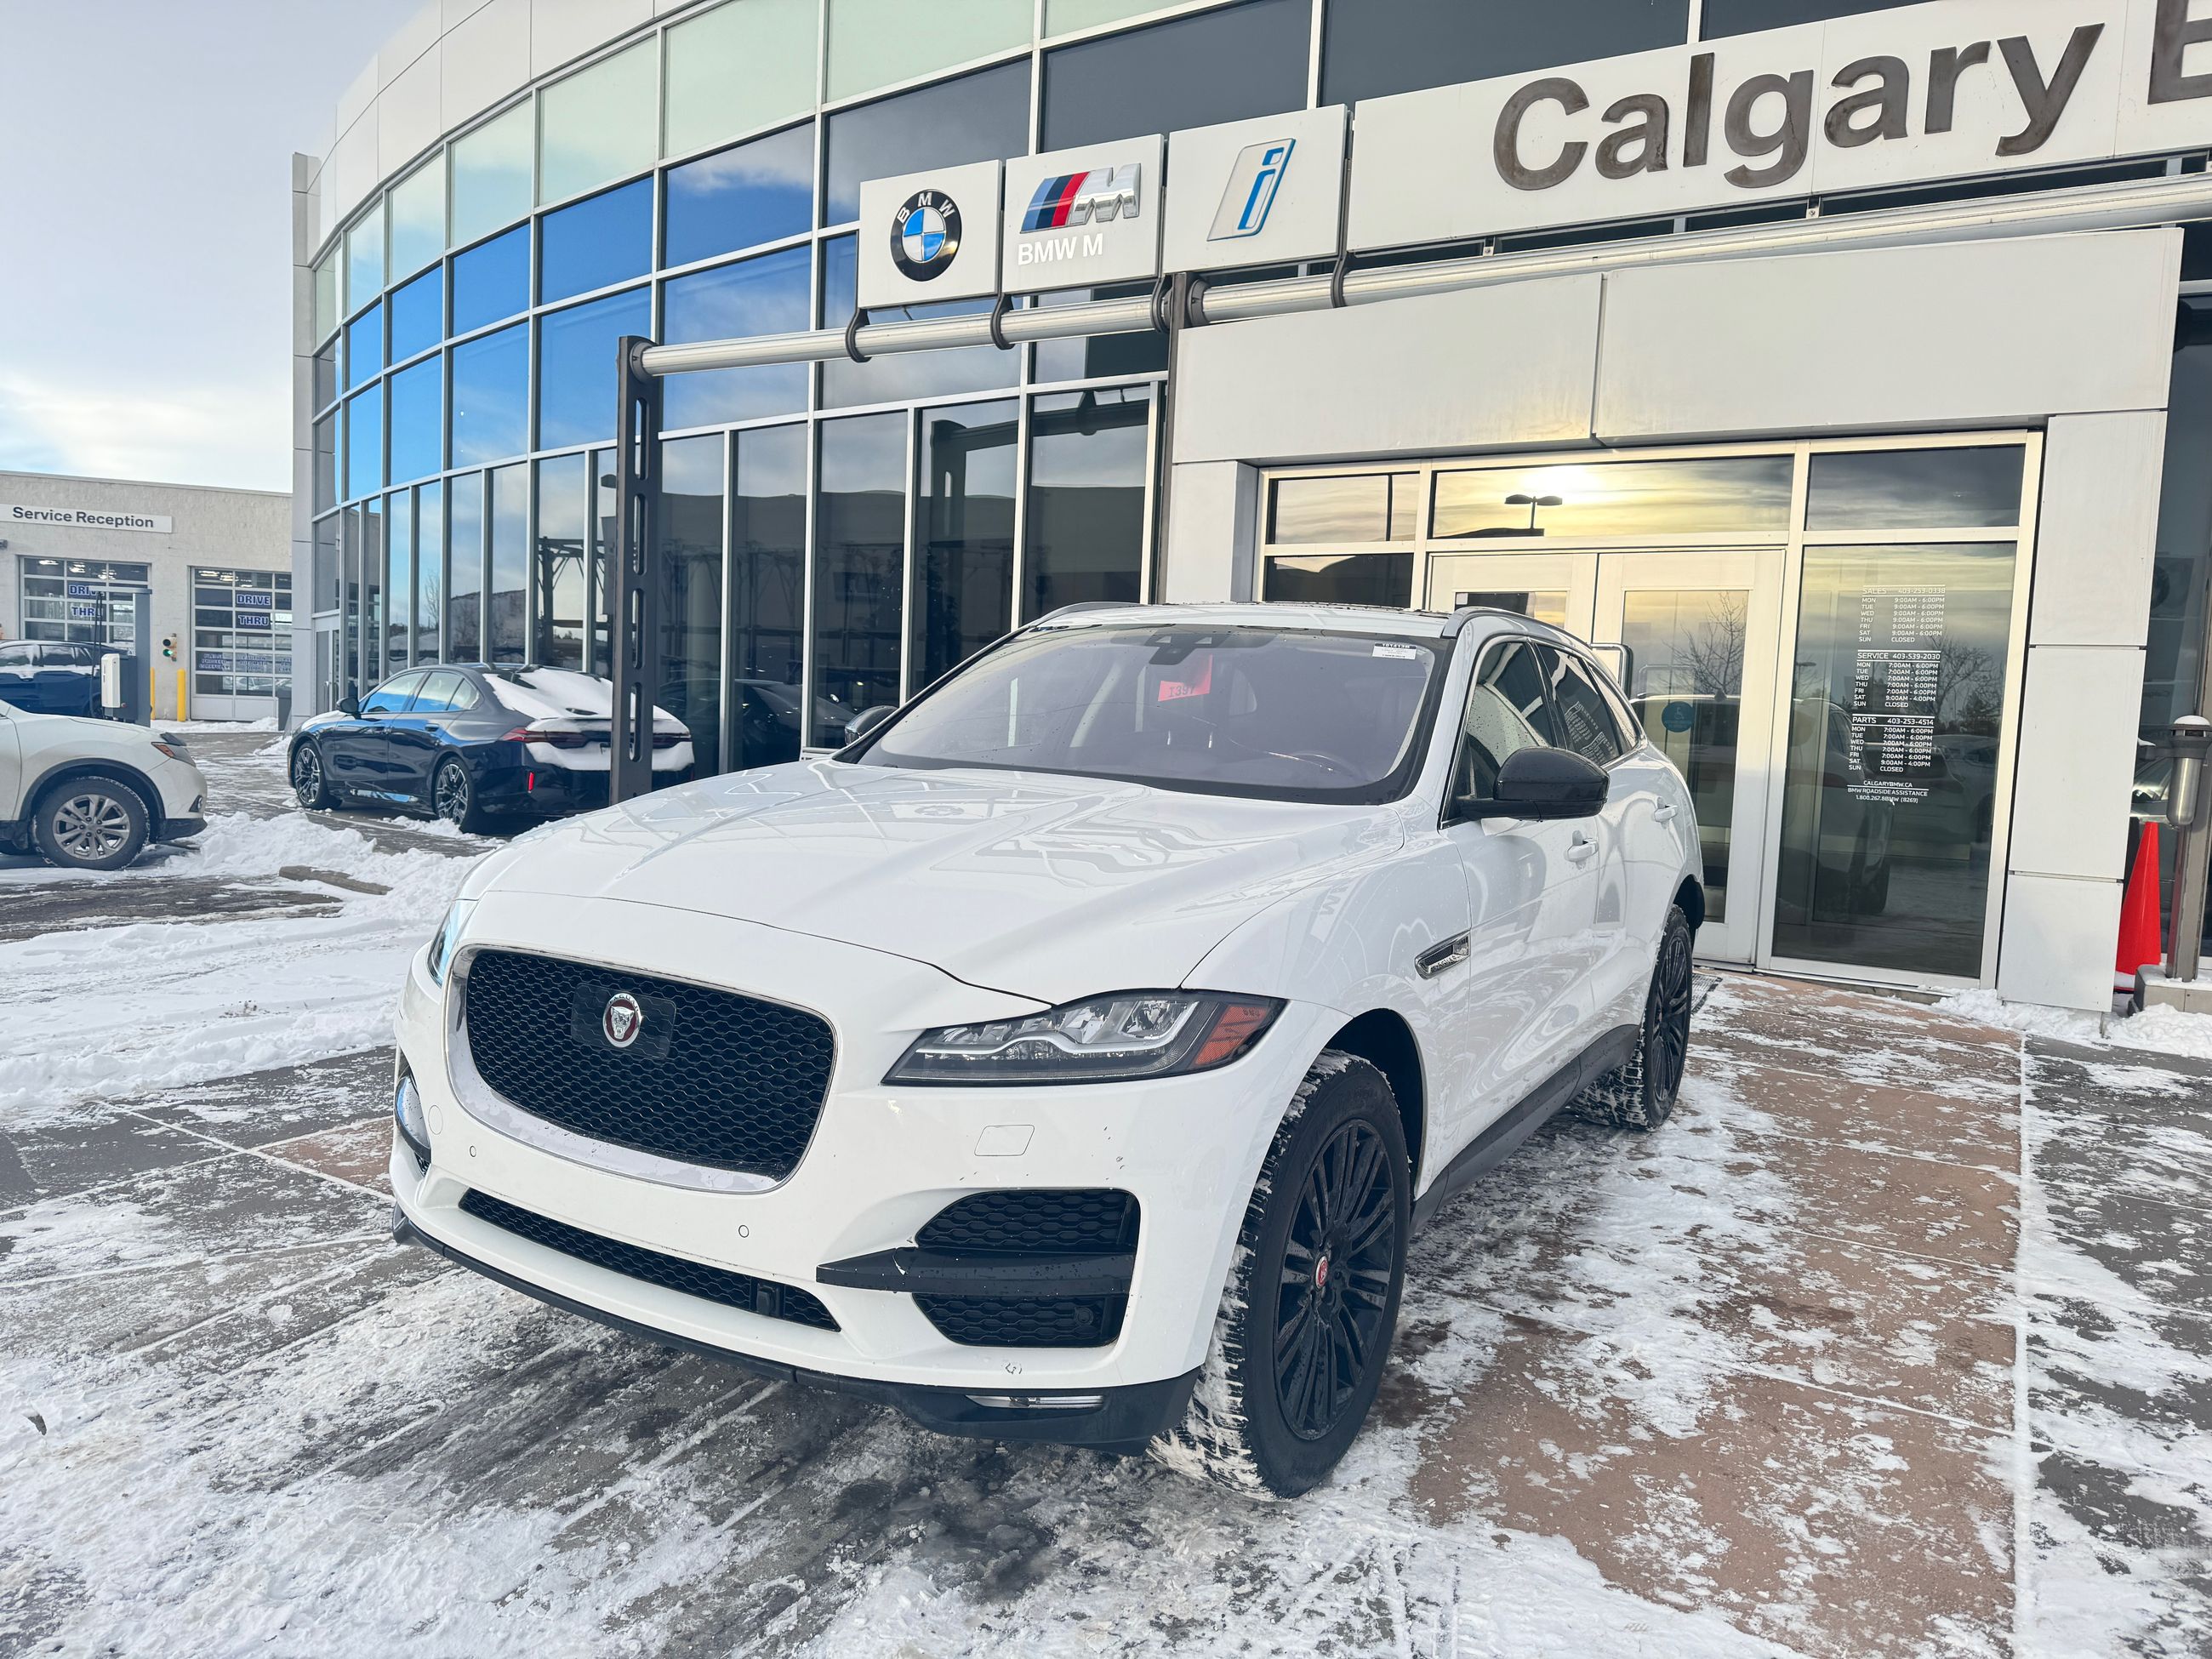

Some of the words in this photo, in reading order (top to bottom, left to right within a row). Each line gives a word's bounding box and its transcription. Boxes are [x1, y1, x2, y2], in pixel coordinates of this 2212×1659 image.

[1493, 23, 2105, 191] Calgary
[897, 192, 955, 224] BMW
[1018, 237, 1076, 265] BMW
[1082, 233, 1103, 257] M
[13, 507, 72, 522] Service
[76, 511, 154, 527] Reception
[69, 584, 105, 596] DRI
[237, 594, 271, 605] DRIVE
[238, 615, 269, 625] THRU
